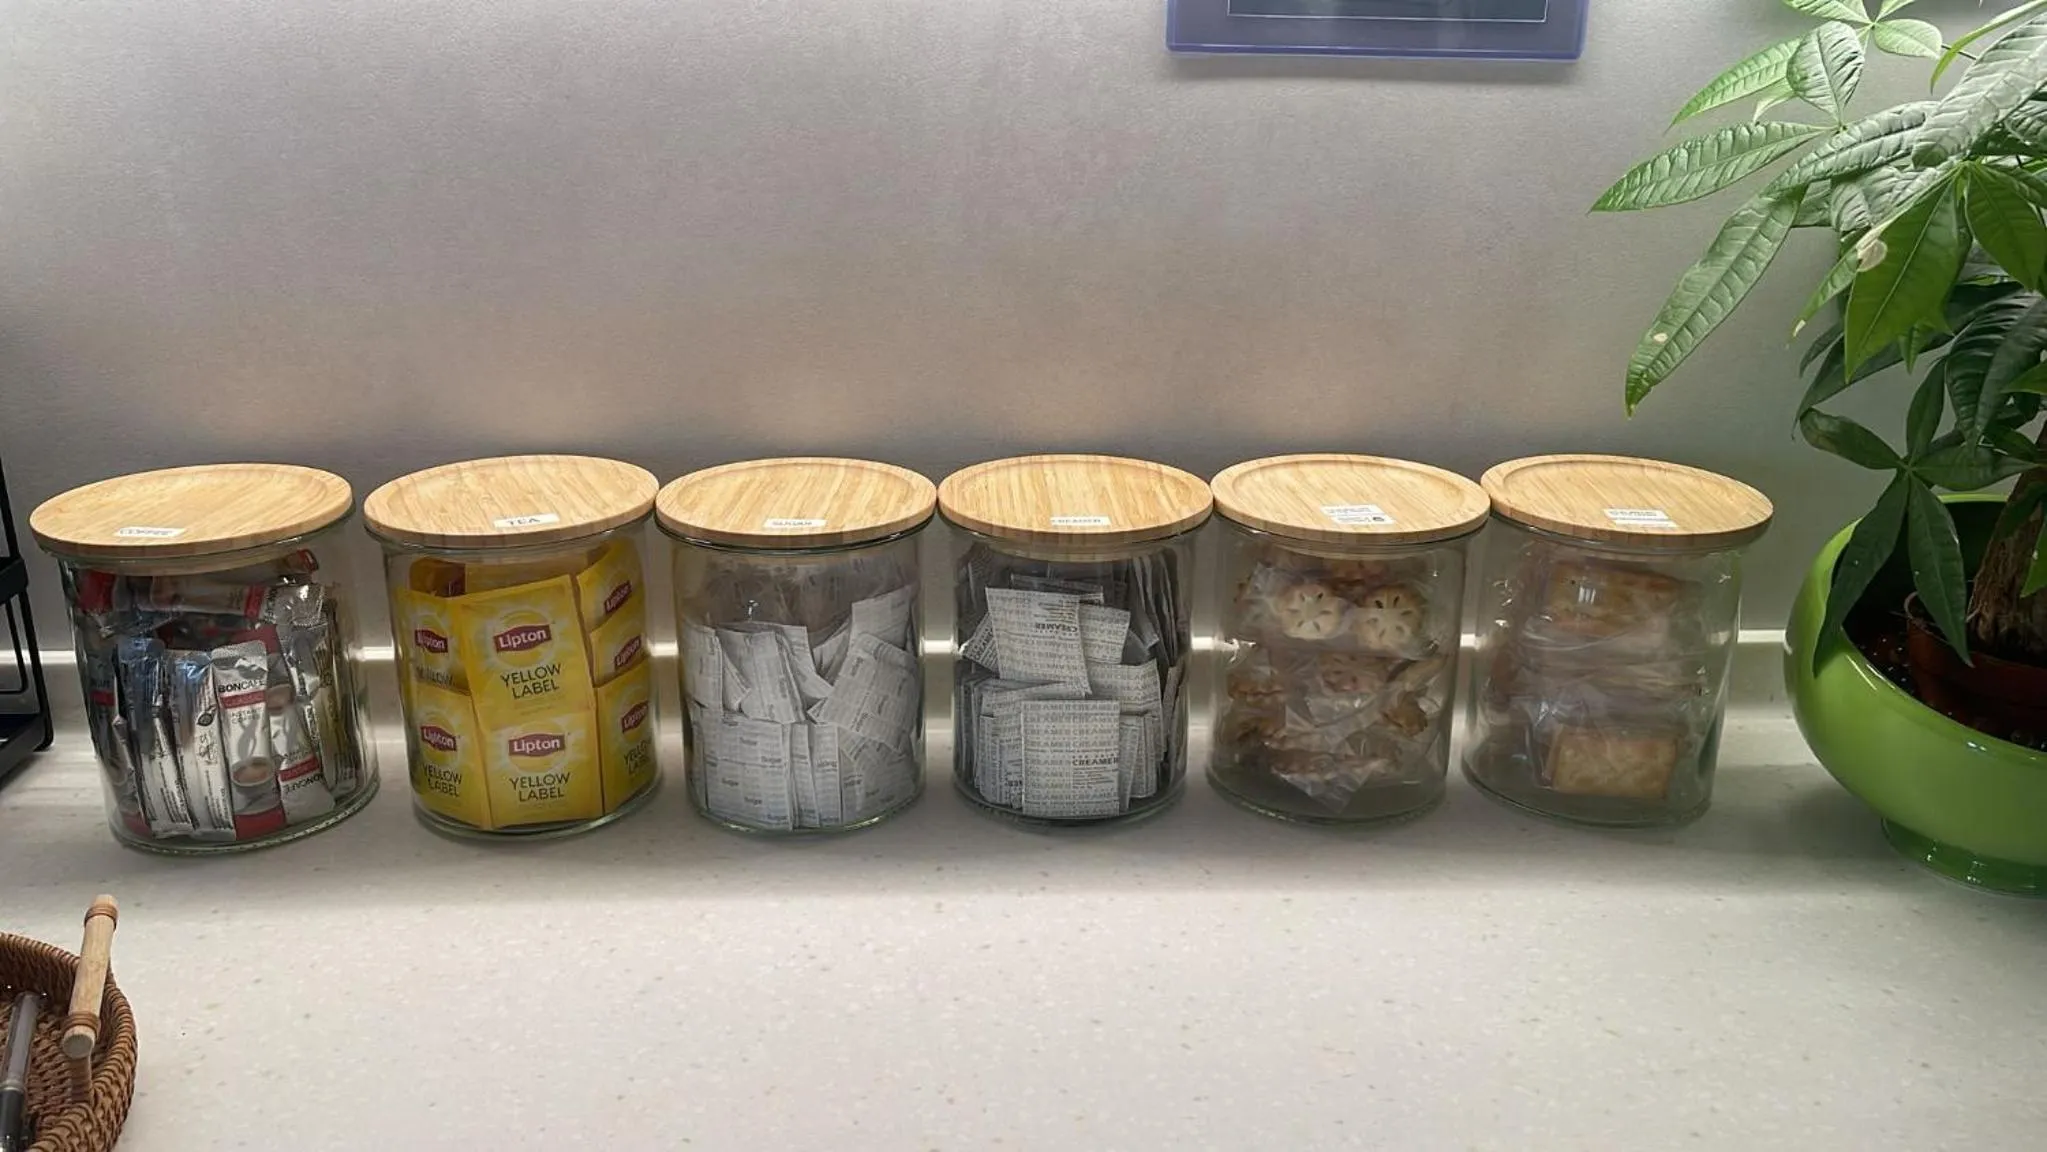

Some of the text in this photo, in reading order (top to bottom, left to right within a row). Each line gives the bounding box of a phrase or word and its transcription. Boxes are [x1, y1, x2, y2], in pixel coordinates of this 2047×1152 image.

[507, 517, 541, 525] TEA
[499, 629, 548, 649] Lipton
[500, 663, 562, 689] YELLOW
[511, 679, 560, 700] LABEL
[513, 739, 561, 755] Lipton
[423, 765, 463, 785] YELLOW
[508, 772, 571, 791] YELLOW
[428, 779, 460, 797] LABEL
[518, 786, 565, 803] LABEL
